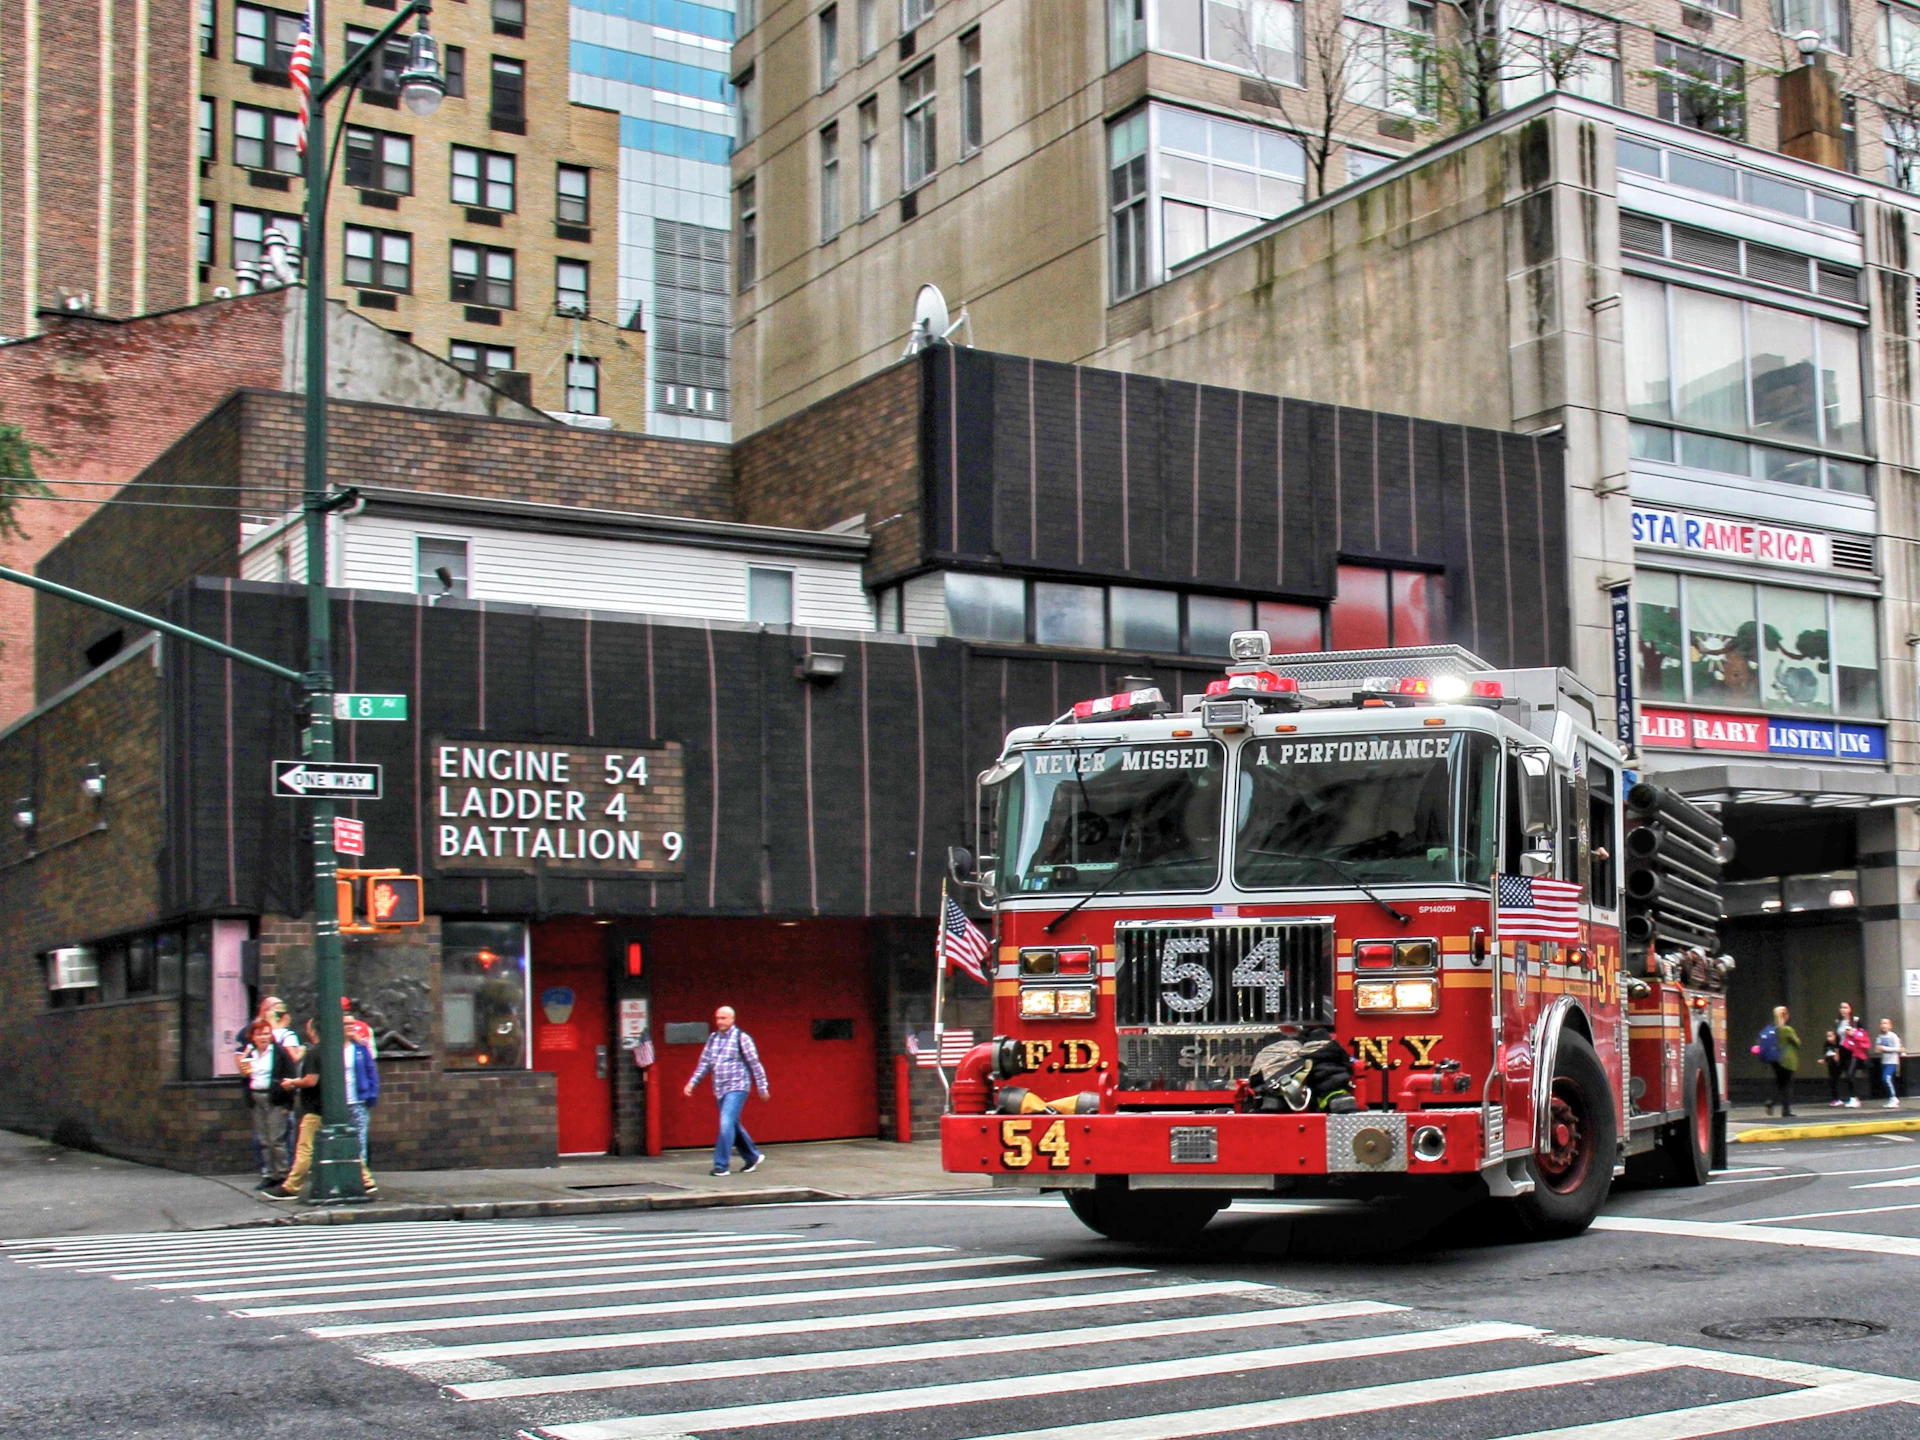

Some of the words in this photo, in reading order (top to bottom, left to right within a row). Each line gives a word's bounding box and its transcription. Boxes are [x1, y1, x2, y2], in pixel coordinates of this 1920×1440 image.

[1615, 609, 1630, 739] PHYSICIANS
[358, 698, 373, 717] 8
[1256, 745, 1269, 766] A
[1280, 737, 1450, 765] PERFORMANCE
[1639, 714, 1760, 744] LIBRARY
[1769, 726, 1871, 754] LISTENING
[439, 746, 570, 783] ENGINE
[604, 754, 649, 786] 54
[1034, 752, 1105, 775] NEVER
[1121, 748, 1209, 771] MISSED
[294, 773, 326, 786] ONE
[333, 774, 366, 788] WAY
[439, 785, 587, 822] LADDER
[604, 792, 628, 823] 4
[439, 825, 641, 861] BATTALION
[661, 831, 683, 862] 9
[1418, 905, 1456, 914] SP14002H
[1160, 937, 1286, 1014] 54
[1596, 944, 1617, 1005] 54
[1021, 1039, 1109, 1070] F.D.
[1002, 1119, 1071, 1167] 54
